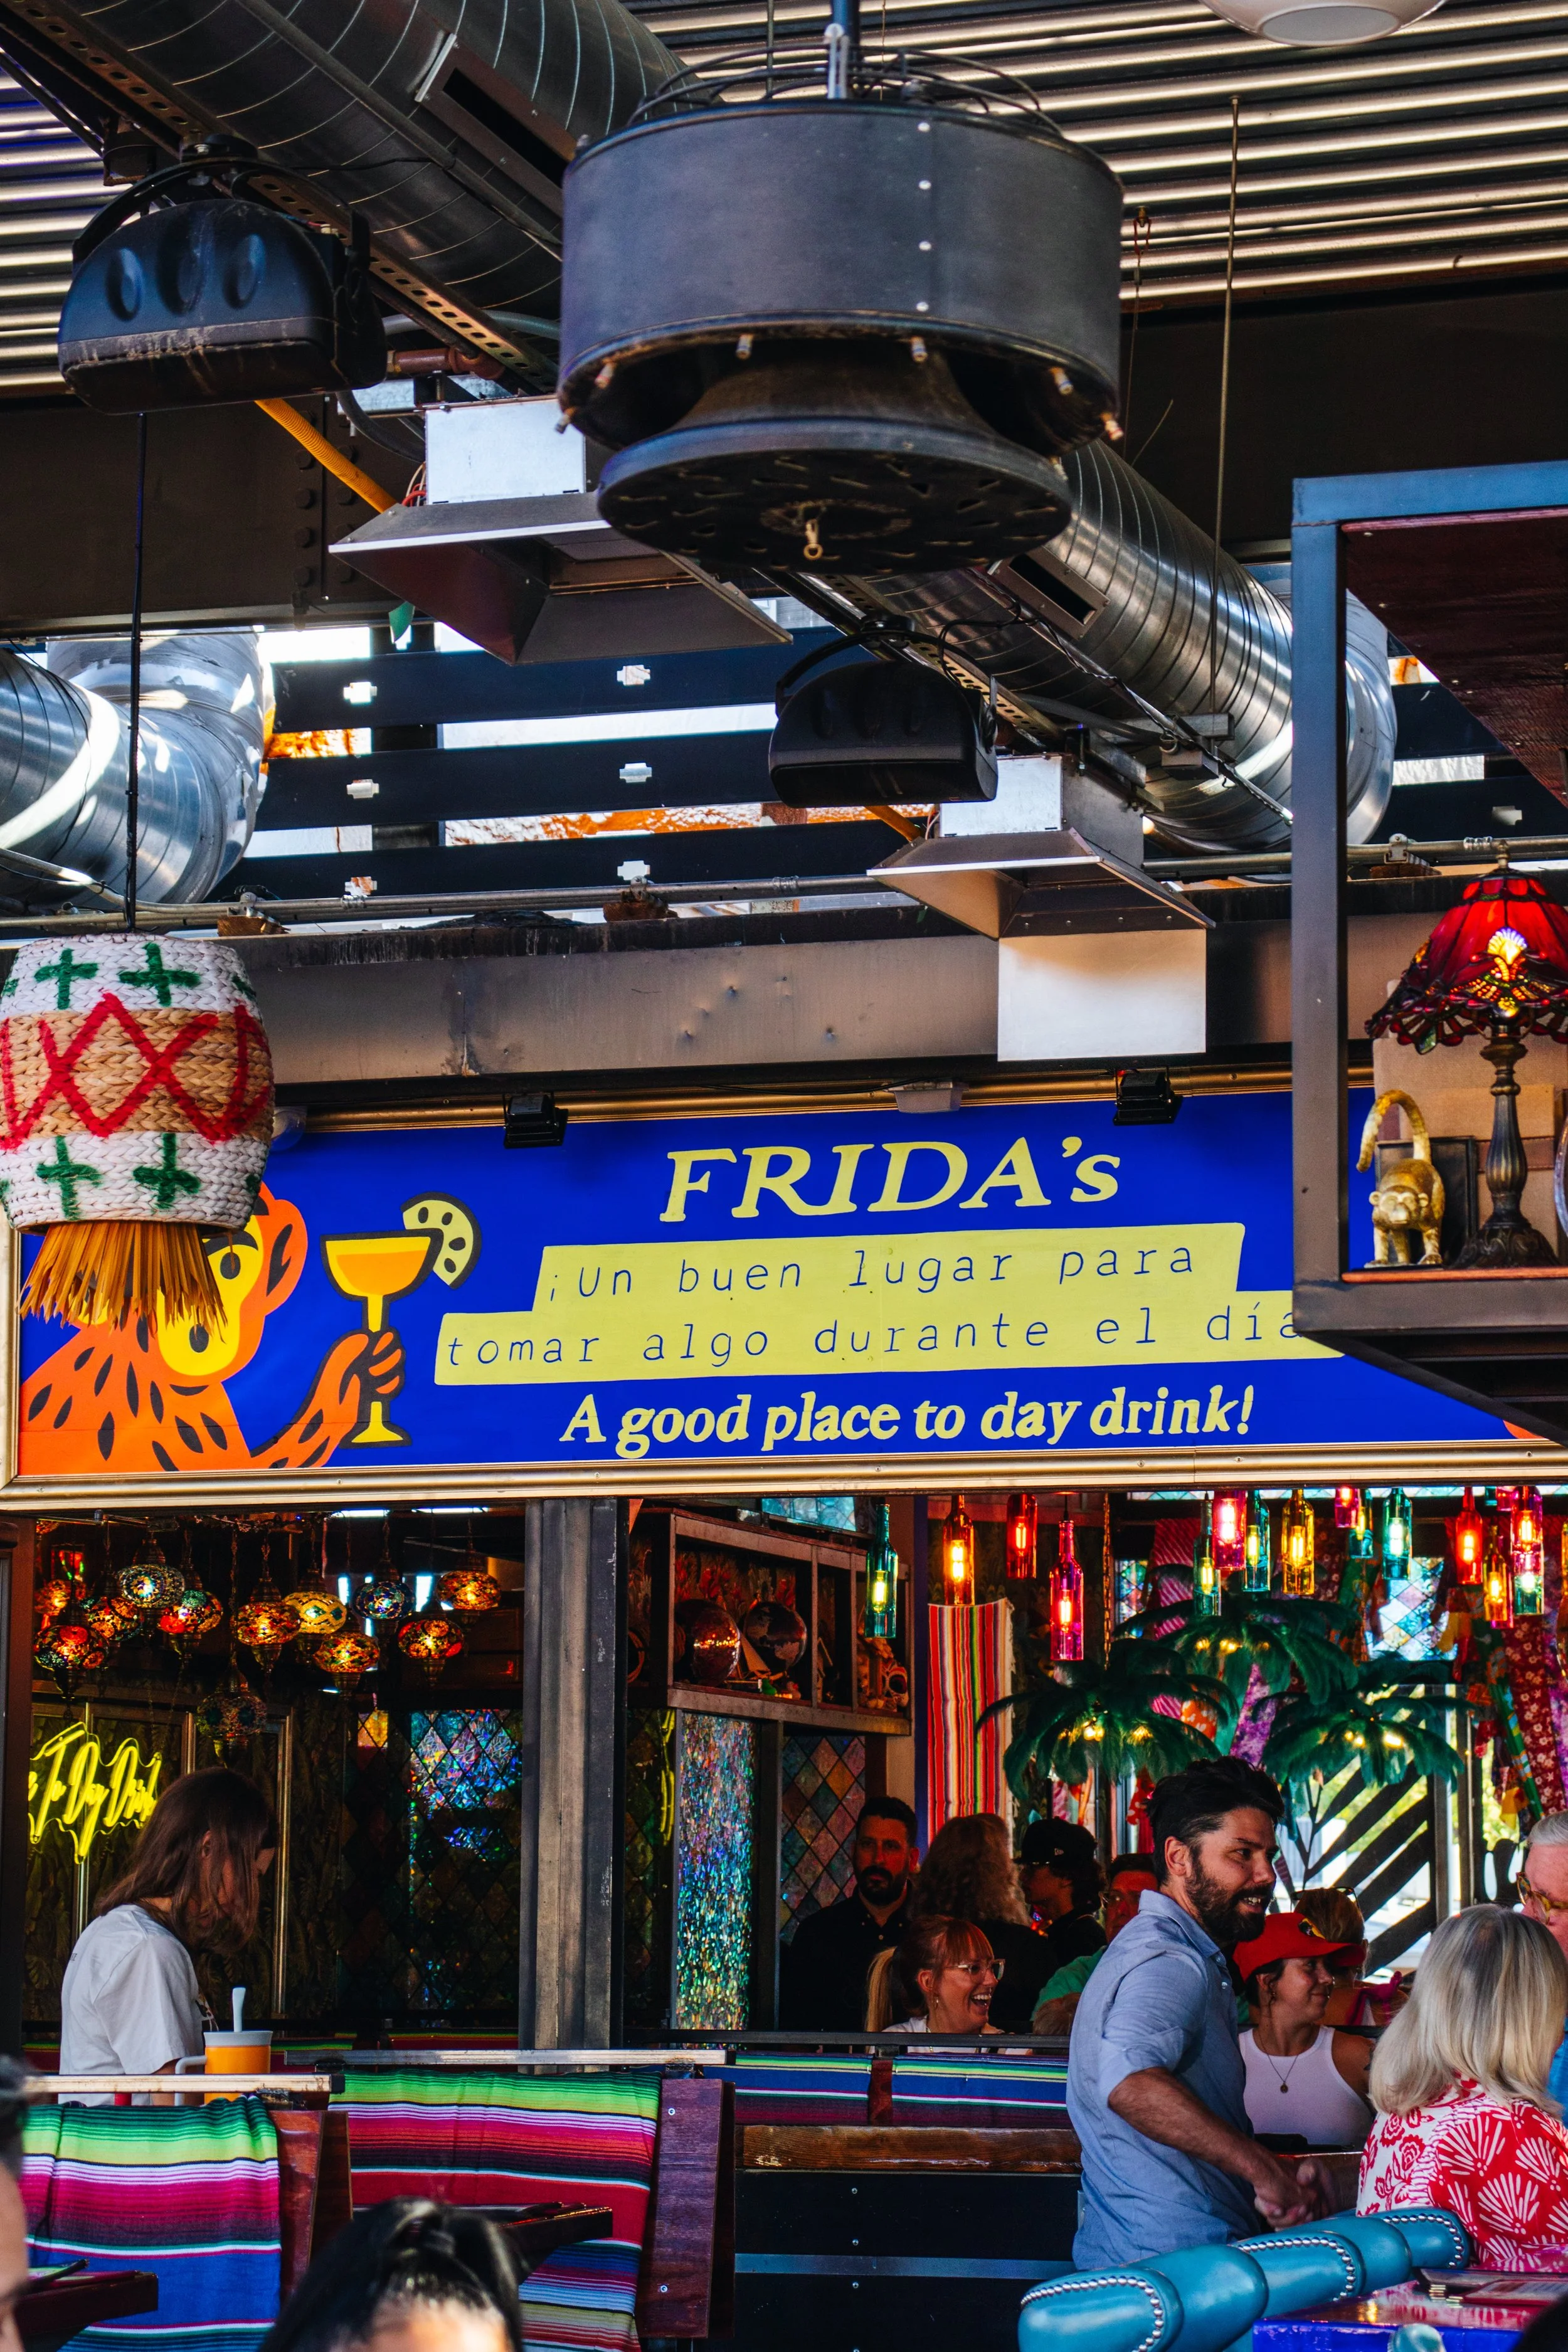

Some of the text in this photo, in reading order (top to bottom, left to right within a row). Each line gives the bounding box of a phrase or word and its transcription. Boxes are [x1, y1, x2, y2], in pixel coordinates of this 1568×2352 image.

[659, 1136, 1121, 1222] FRIDA's
[549, 1246, 1193, 1301] ¡Un buen lugar para
[448, 1336, 600, 1367] tomar
[643, 1323, 768, 1367] algo
[815, 1313, 1048, 1353] durante
[1096, 1306, 1157, 1345] el
[559, 1384, 1254, 1459] A good place to day drink!
